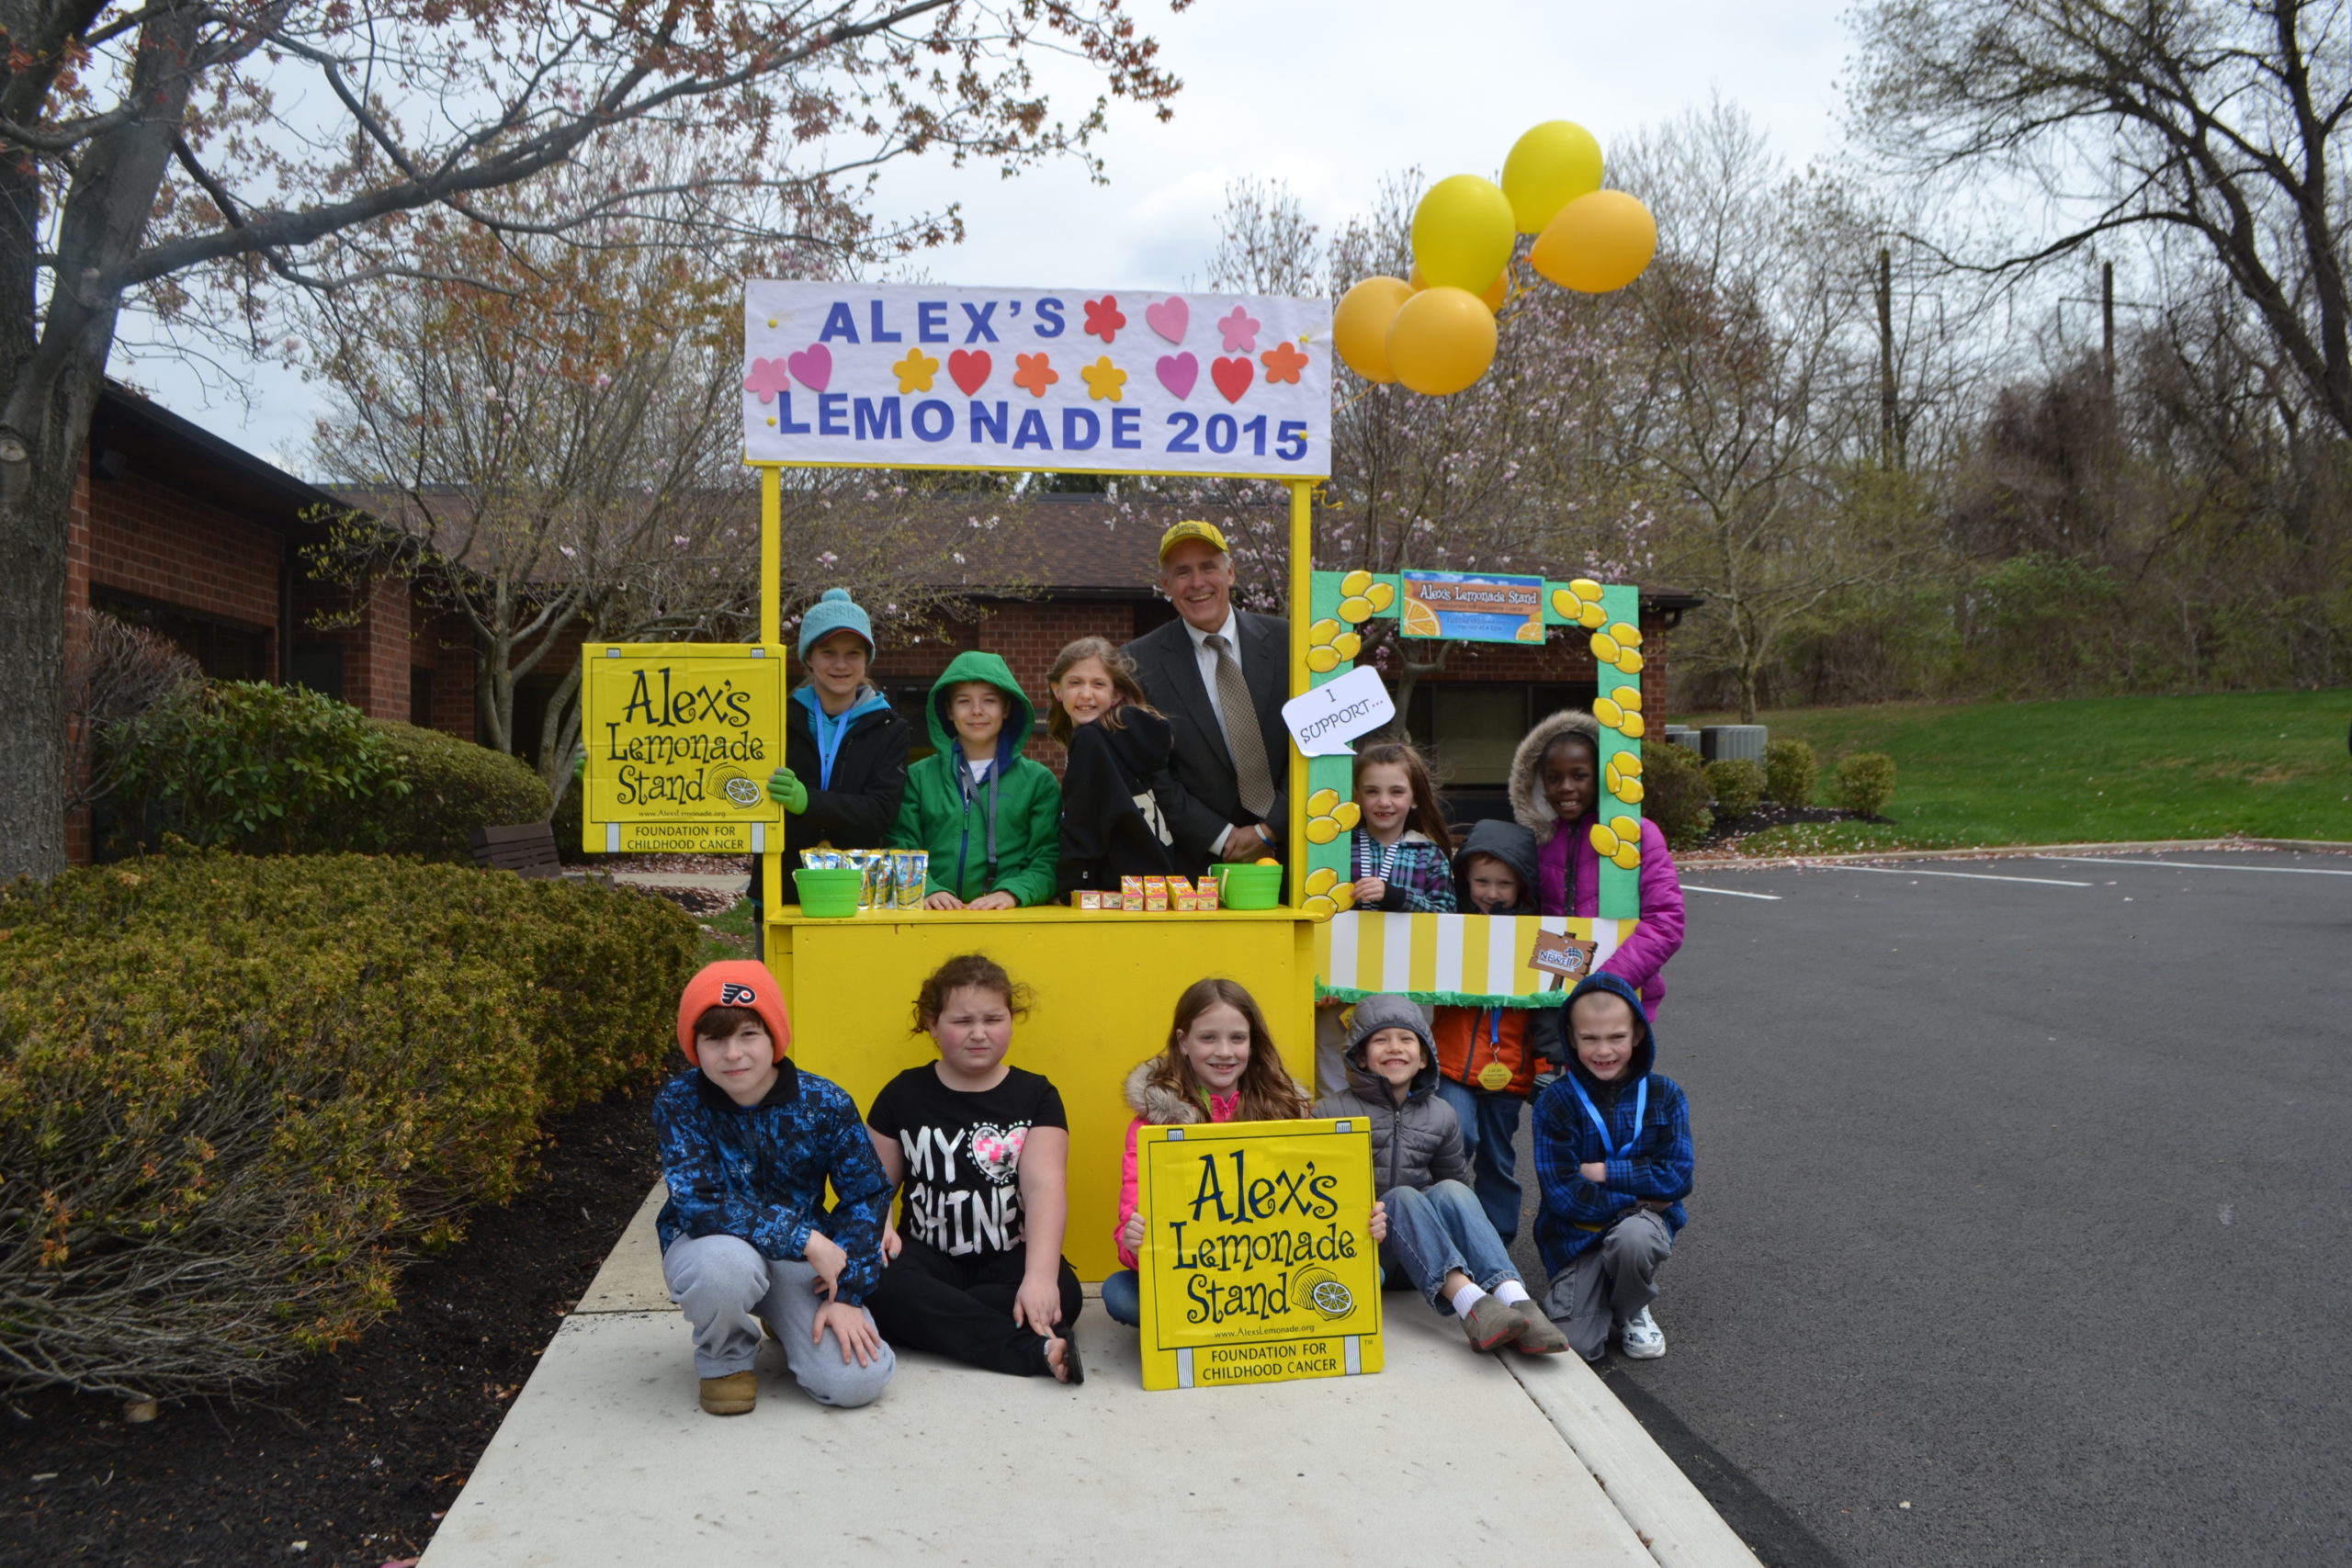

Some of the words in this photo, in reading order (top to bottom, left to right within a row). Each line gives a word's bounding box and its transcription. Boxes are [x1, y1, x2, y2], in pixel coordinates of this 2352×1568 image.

[819, 297, 1066, 344] ALEX'S
[778, 391, 1142, 451] LEMONADE
[1166, 412, 1308, 461] 2015
[1420, 583, 1451, 601] Alex's
[1454, 586, 1505, 604] Lemonade
[1509, 590, 1536, 604] Stand
[622, 667, 751, 728] Alex's
[1325, 688, 1337, 703] I
[605, 722, 765, 765] Lemonade
[617, 764, 705, 805] Stand
[627, 840, 695, 850] CHILDHOOD
[699, 840, 744, 850] CANCER
[636, 826, 709, 836] FOUNDATION
[715, 826, 736, 836] FOR
[899, 1125, 966, 1184] MY
[1188, 1149, 1338, 1224] Alex's
[1170, 1223, 1357, 1272] Lemonade
[1187, 1272, 1291, 1324] Stand
[1212, 1346, 1296, 1362] FOUNDATION
[1303, 1343, 1327, 1355] FOR
[1215, 1325, 1315, 1338] www.AlexsLemonade.org
[1203, 1363, 1283, 1380] CHILDHOOD
[1287, 1359, 1337, 1373] CANCER
